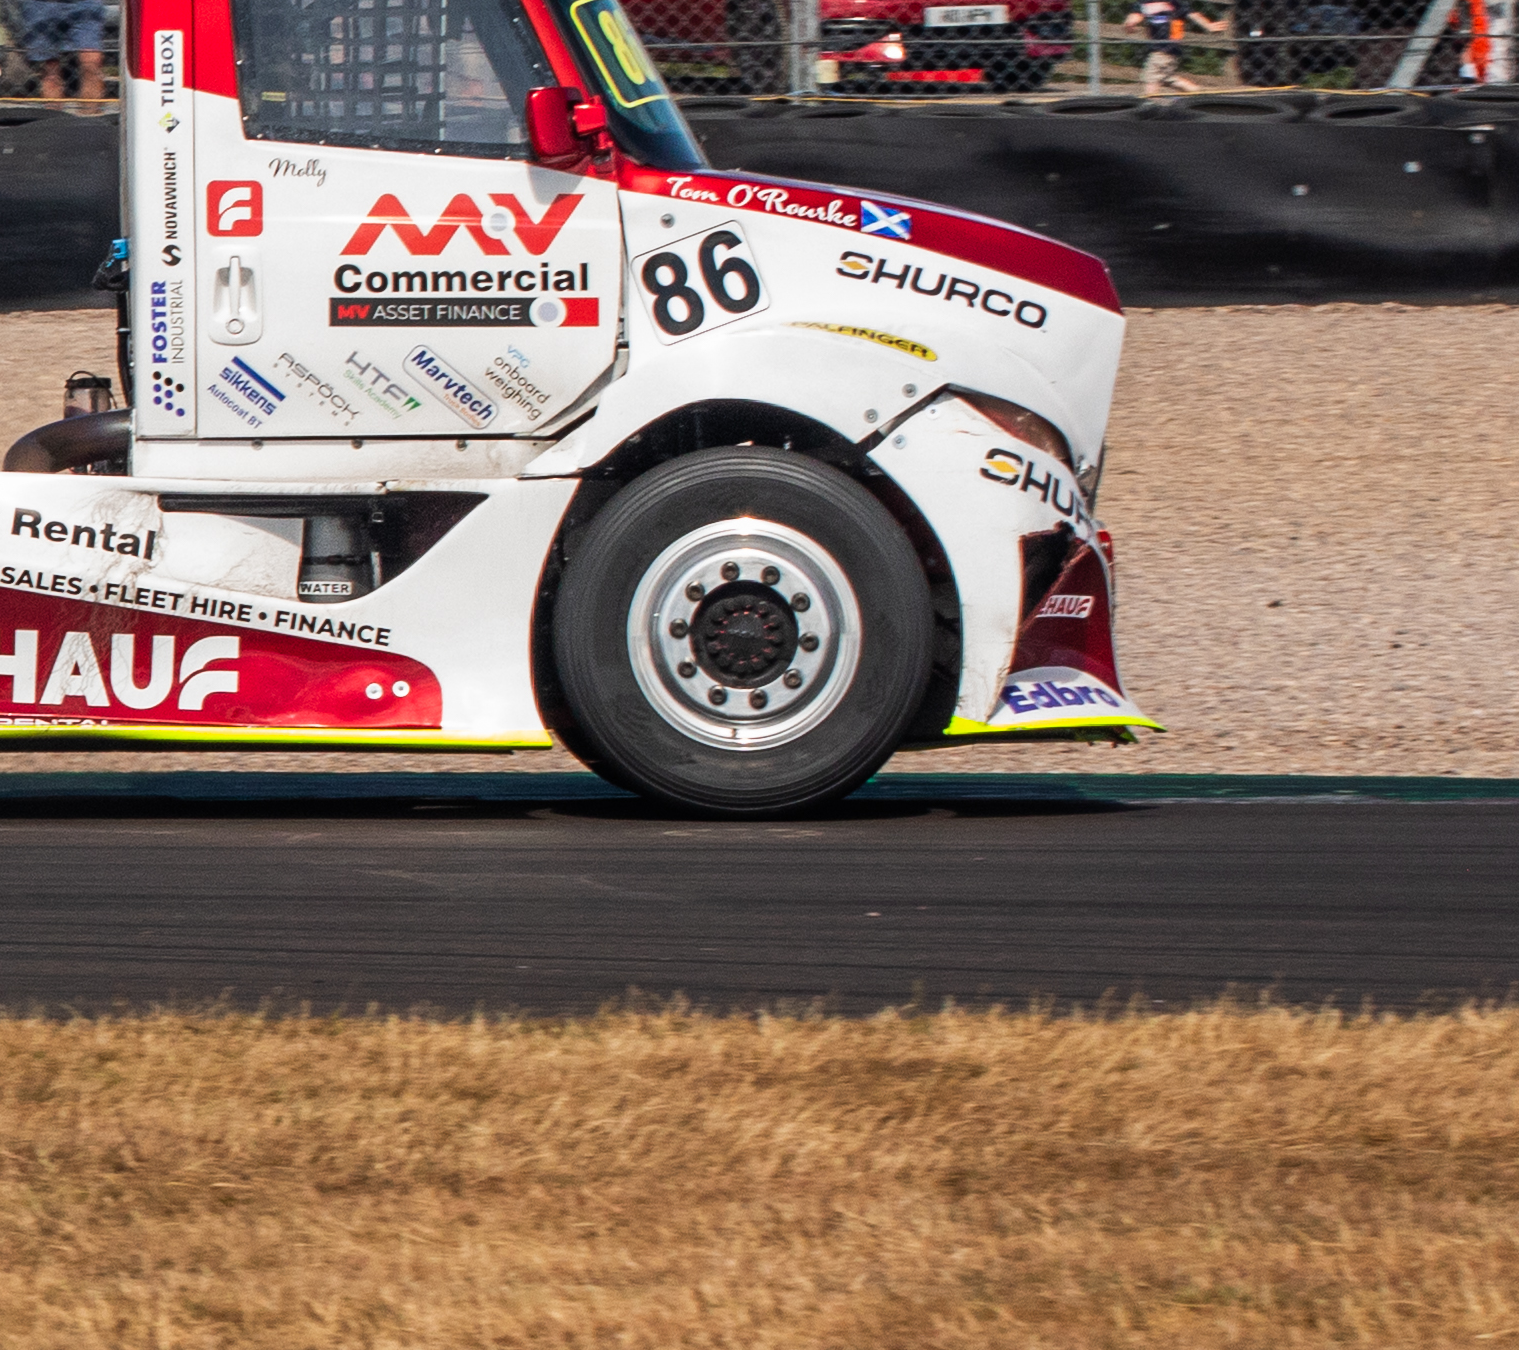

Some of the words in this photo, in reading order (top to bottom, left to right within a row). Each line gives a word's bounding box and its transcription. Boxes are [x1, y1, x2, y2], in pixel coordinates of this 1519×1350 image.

[161, 33, 174, 107] TILBOX
[163, 150, 178, 239] NOVAWINCH
[268, 157, 327, 187] Molly
[339, 193, 586, 256] MV
[666, 176, 719, 202] Tom
[727, 184, 857, 227] O'Rourke
[333, 262, 590, 294] Commercial
[641, 230, 761, 336] 86
[835, 251, 1048, 329] SHURCO
[151, 280, 168, 364] FOSTER
[170, 279, 185, 364] INDUSTRIAL
[337, 304, 371, 320] MV
[372, 304, 431, 321] ASSET
[436, 304, 522, 321] FINANCE
[207, 384, 249, 419] Autocoat
[247, 415, 263, 429] BT
[219, 367, 277, 416] sikkens
[278, 352, 360, 420] ASPÖCK
[364, 388, 403, 420] Academy
[411, 350, 492, 420] Marvtech
[485, 367, 542, 421] weighing
[494, 357, 551, 404] onboard
[11, 507, 157, 561] Rental
[0, 565, 82, 597] SALES
[104, 582, 185, 613] FLEET
[191, 594, 253, 624] HIRE
[272, 609, 392, 647] FINANCE
[299, 583, 350, 593] WATER
[1000, 680, 1121, 715] Edbro
